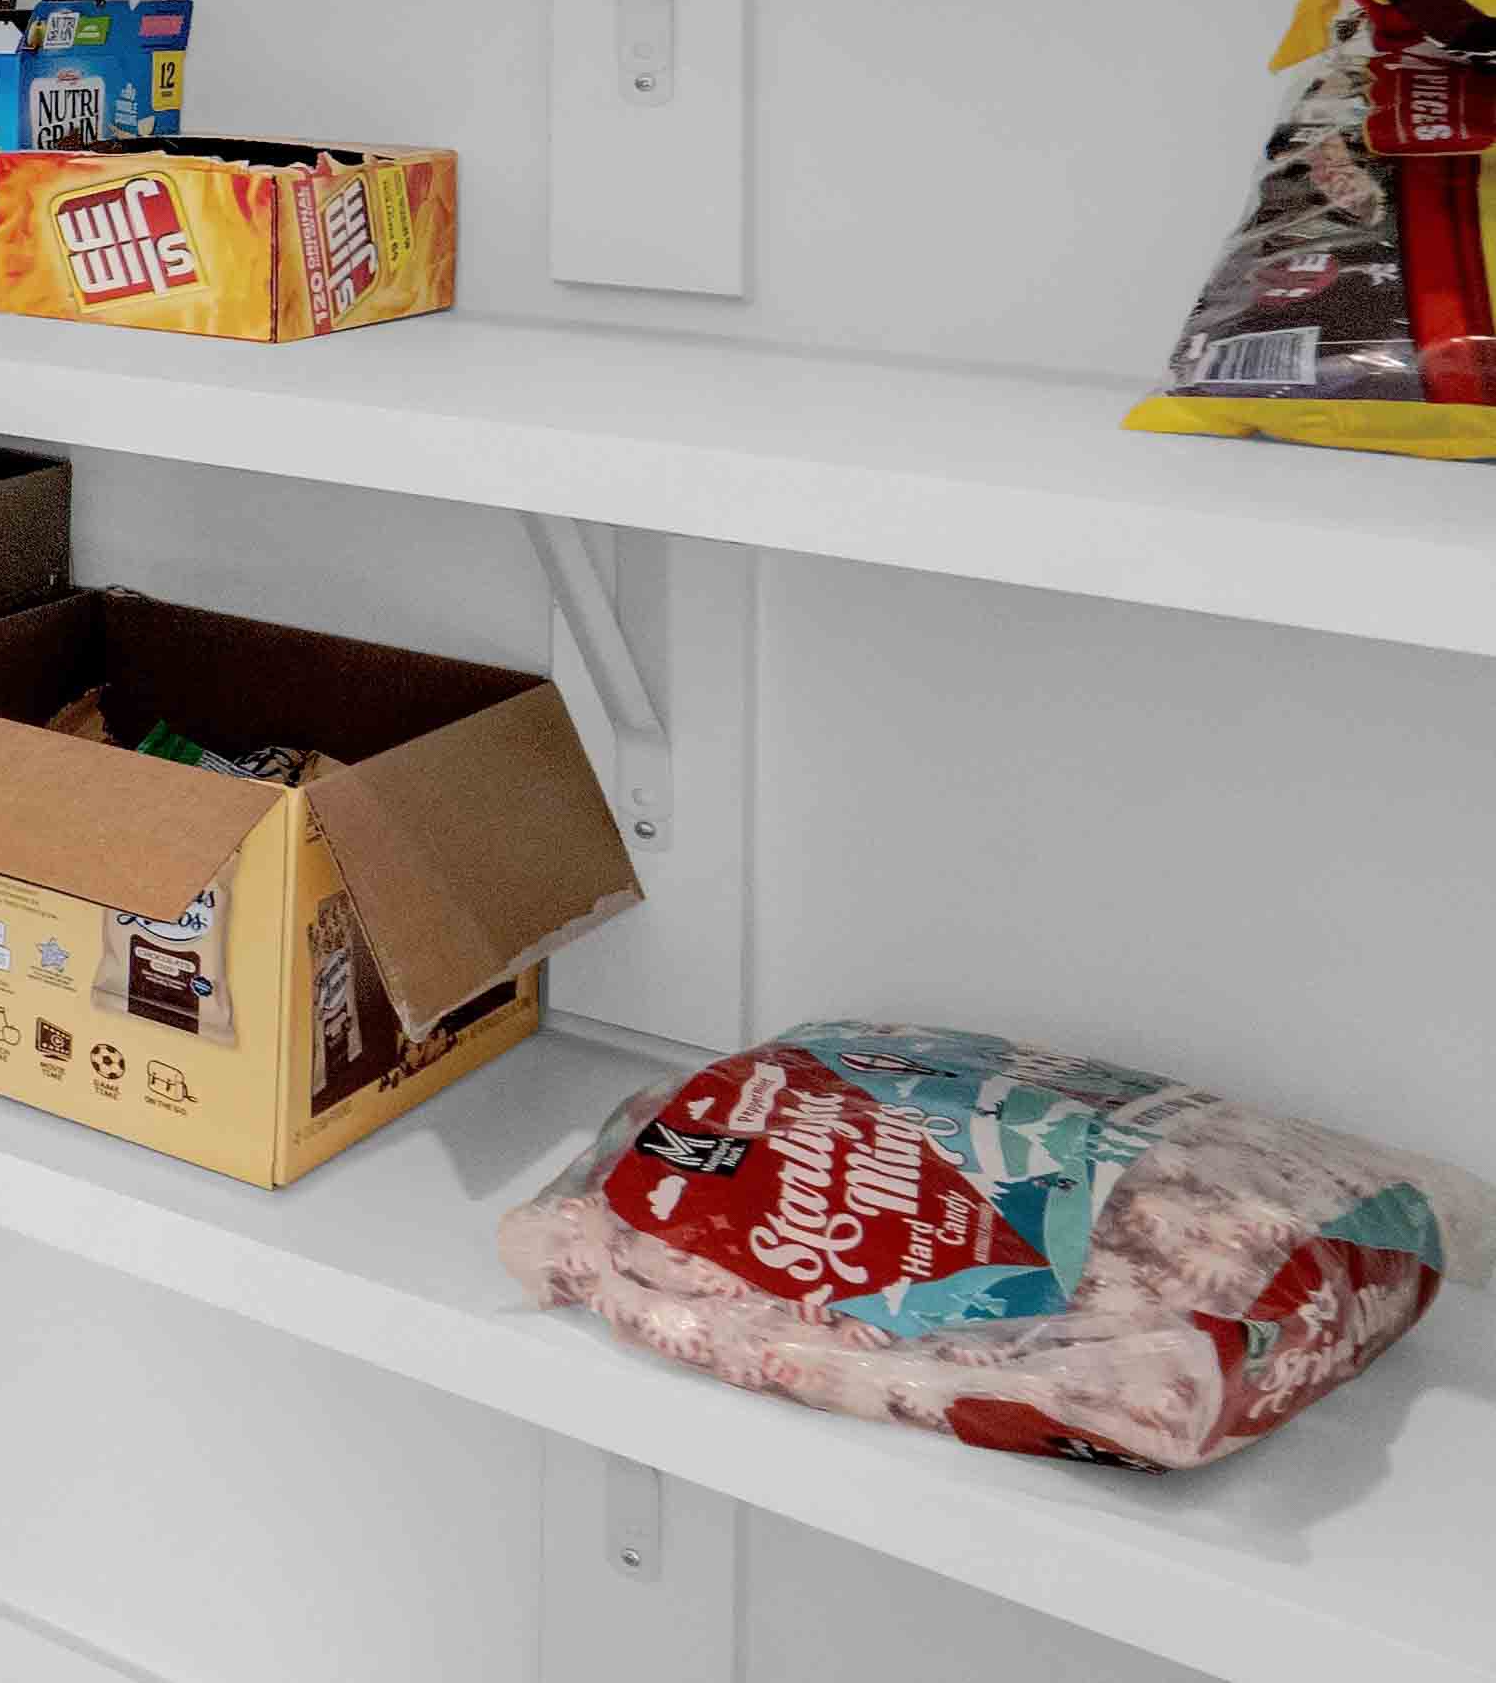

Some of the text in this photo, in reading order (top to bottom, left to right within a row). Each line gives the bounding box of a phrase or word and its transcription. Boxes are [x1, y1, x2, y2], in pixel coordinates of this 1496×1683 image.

[159, 61, 177, 90] 12
[38, 88, 100, 128] NUTRI
[737, 1075, 776, 1126] Peppermint
[749, 1088, 870, 1285] Starlight
[843, 1102, 964, 1217] Mints
[900, 1218, 937, 1278] Hard
[937, 1188, 980, 1248] Candy
